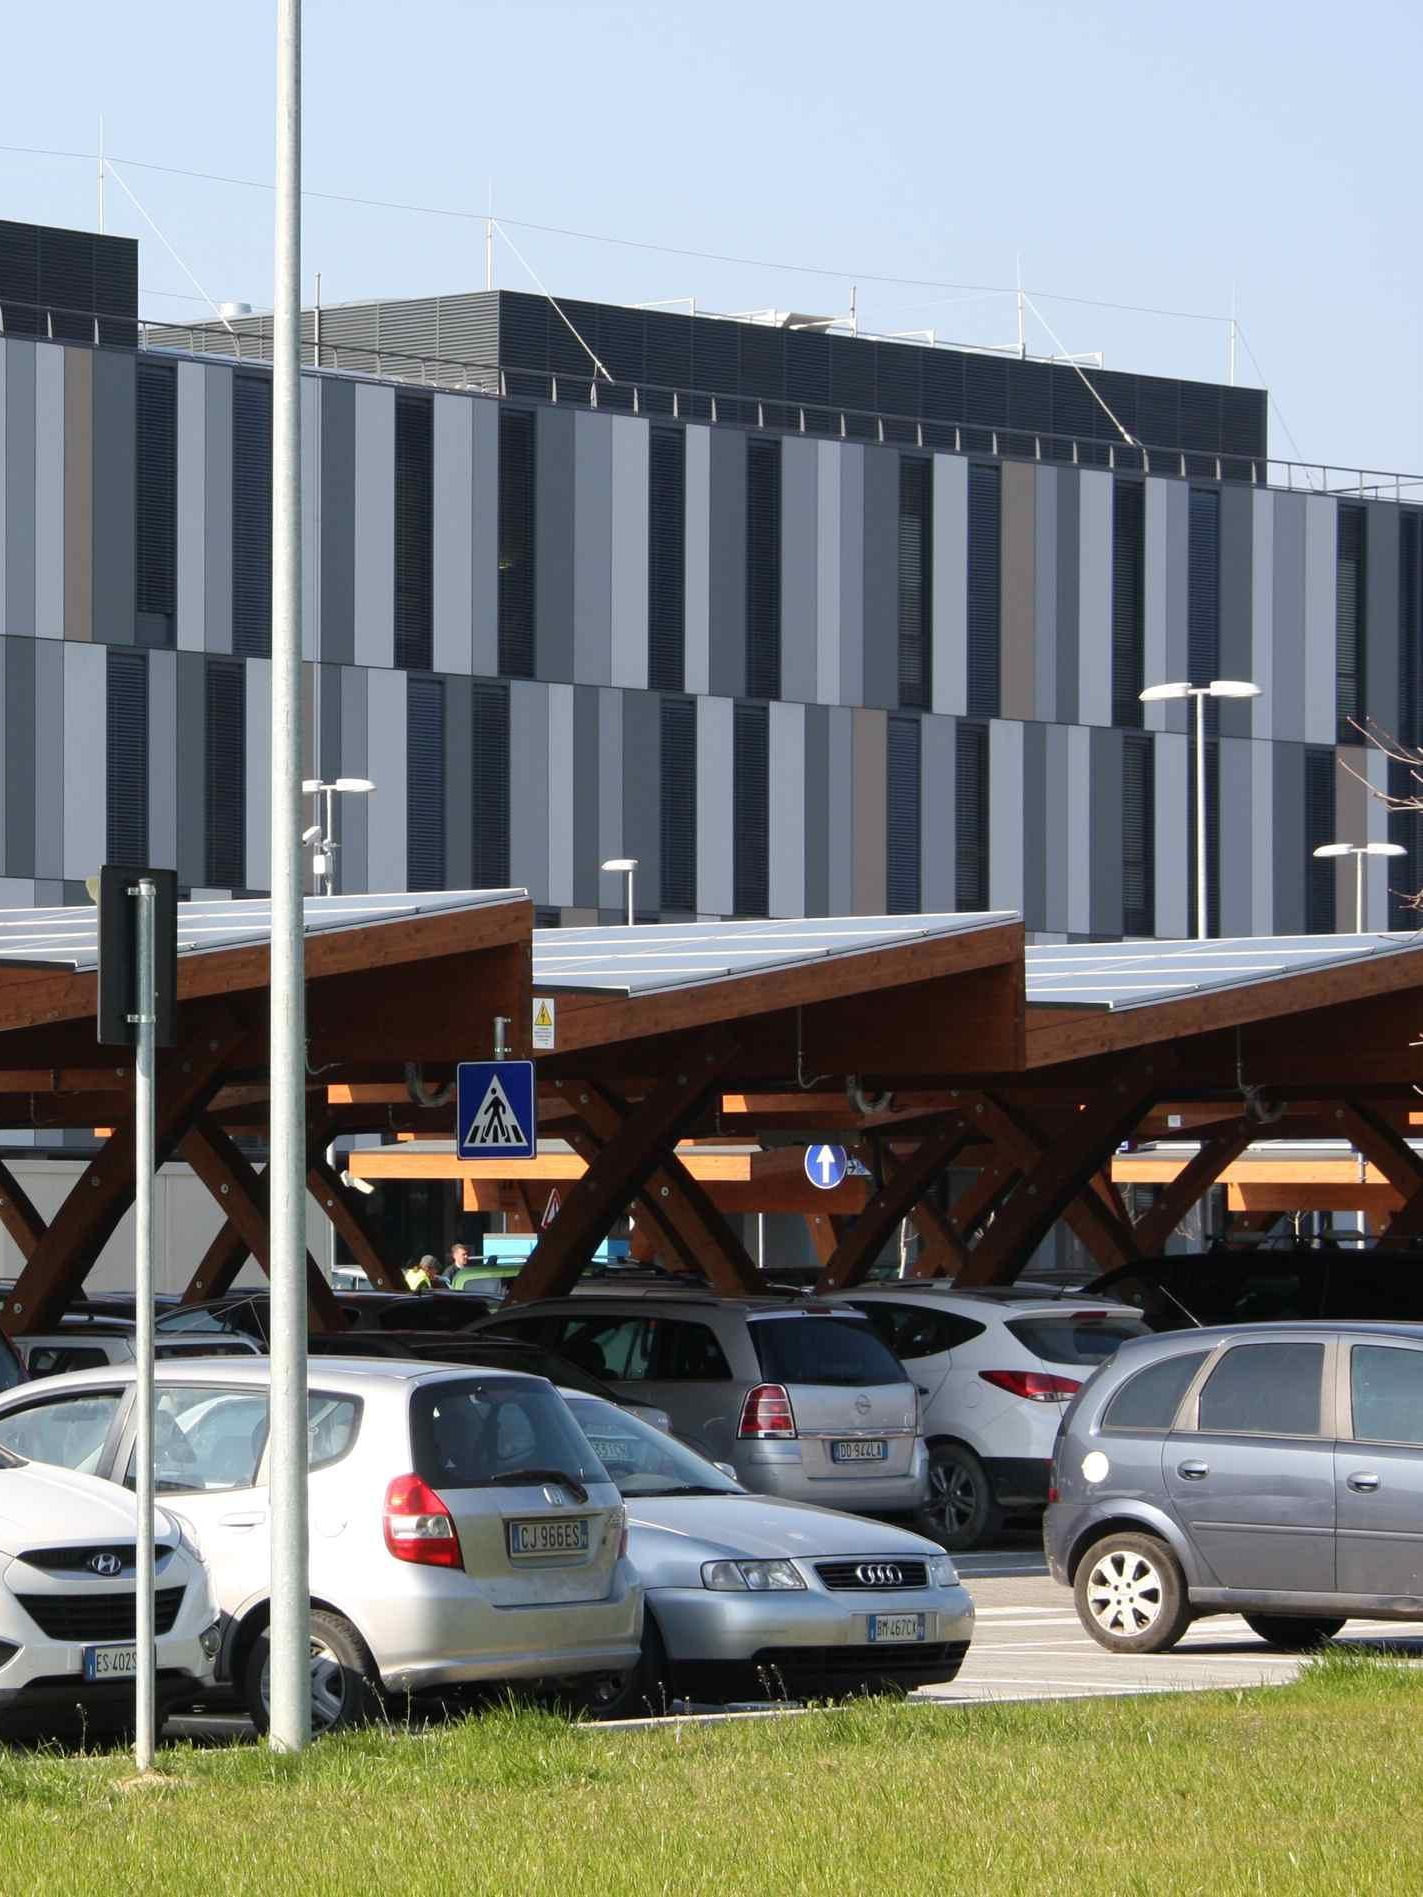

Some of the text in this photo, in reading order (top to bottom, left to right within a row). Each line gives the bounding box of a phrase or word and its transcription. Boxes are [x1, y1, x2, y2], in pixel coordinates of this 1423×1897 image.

[520, 1523, 579, 1549] CJ 966ES
[96, 1650, 137, 1673] ES 402S
